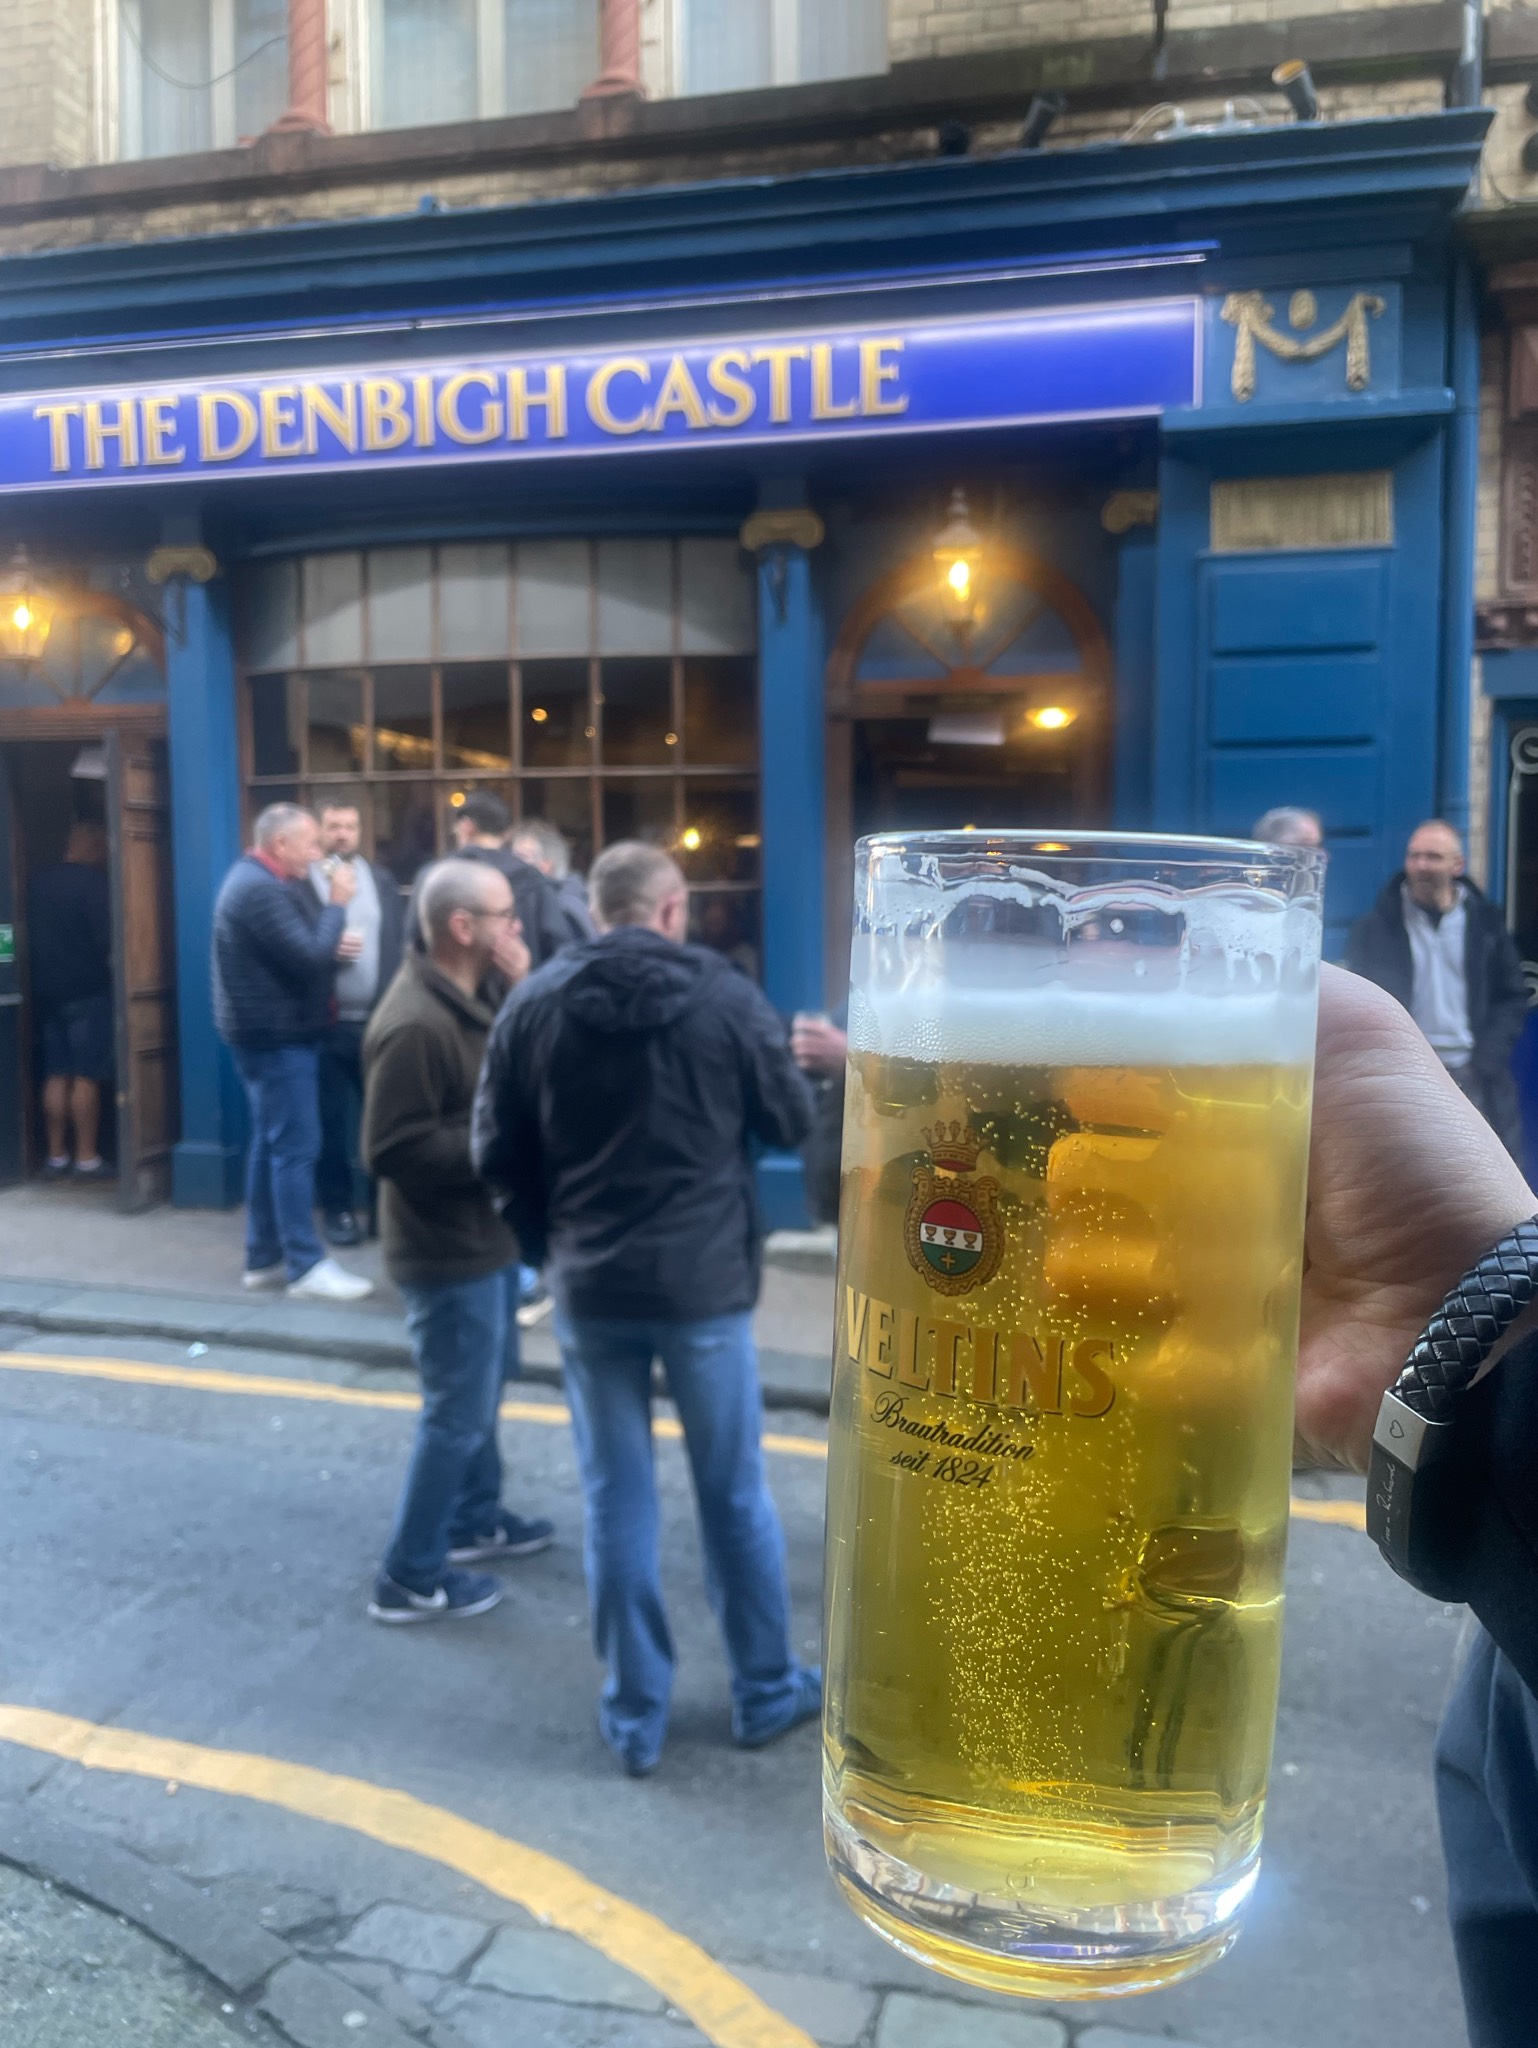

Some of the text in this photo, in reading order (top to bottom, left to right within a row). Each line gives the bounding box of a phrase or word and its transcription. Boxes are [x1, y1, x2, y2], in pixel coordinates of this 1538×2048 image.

[33, 338, 909, 472] THE DENBIGH CASTLE
[846, 1284, 1116, 1418] VELTINS
[870, 1390, 1036, 1461] Brautradition
[889, 1449, 994, 1489] seit 1824
